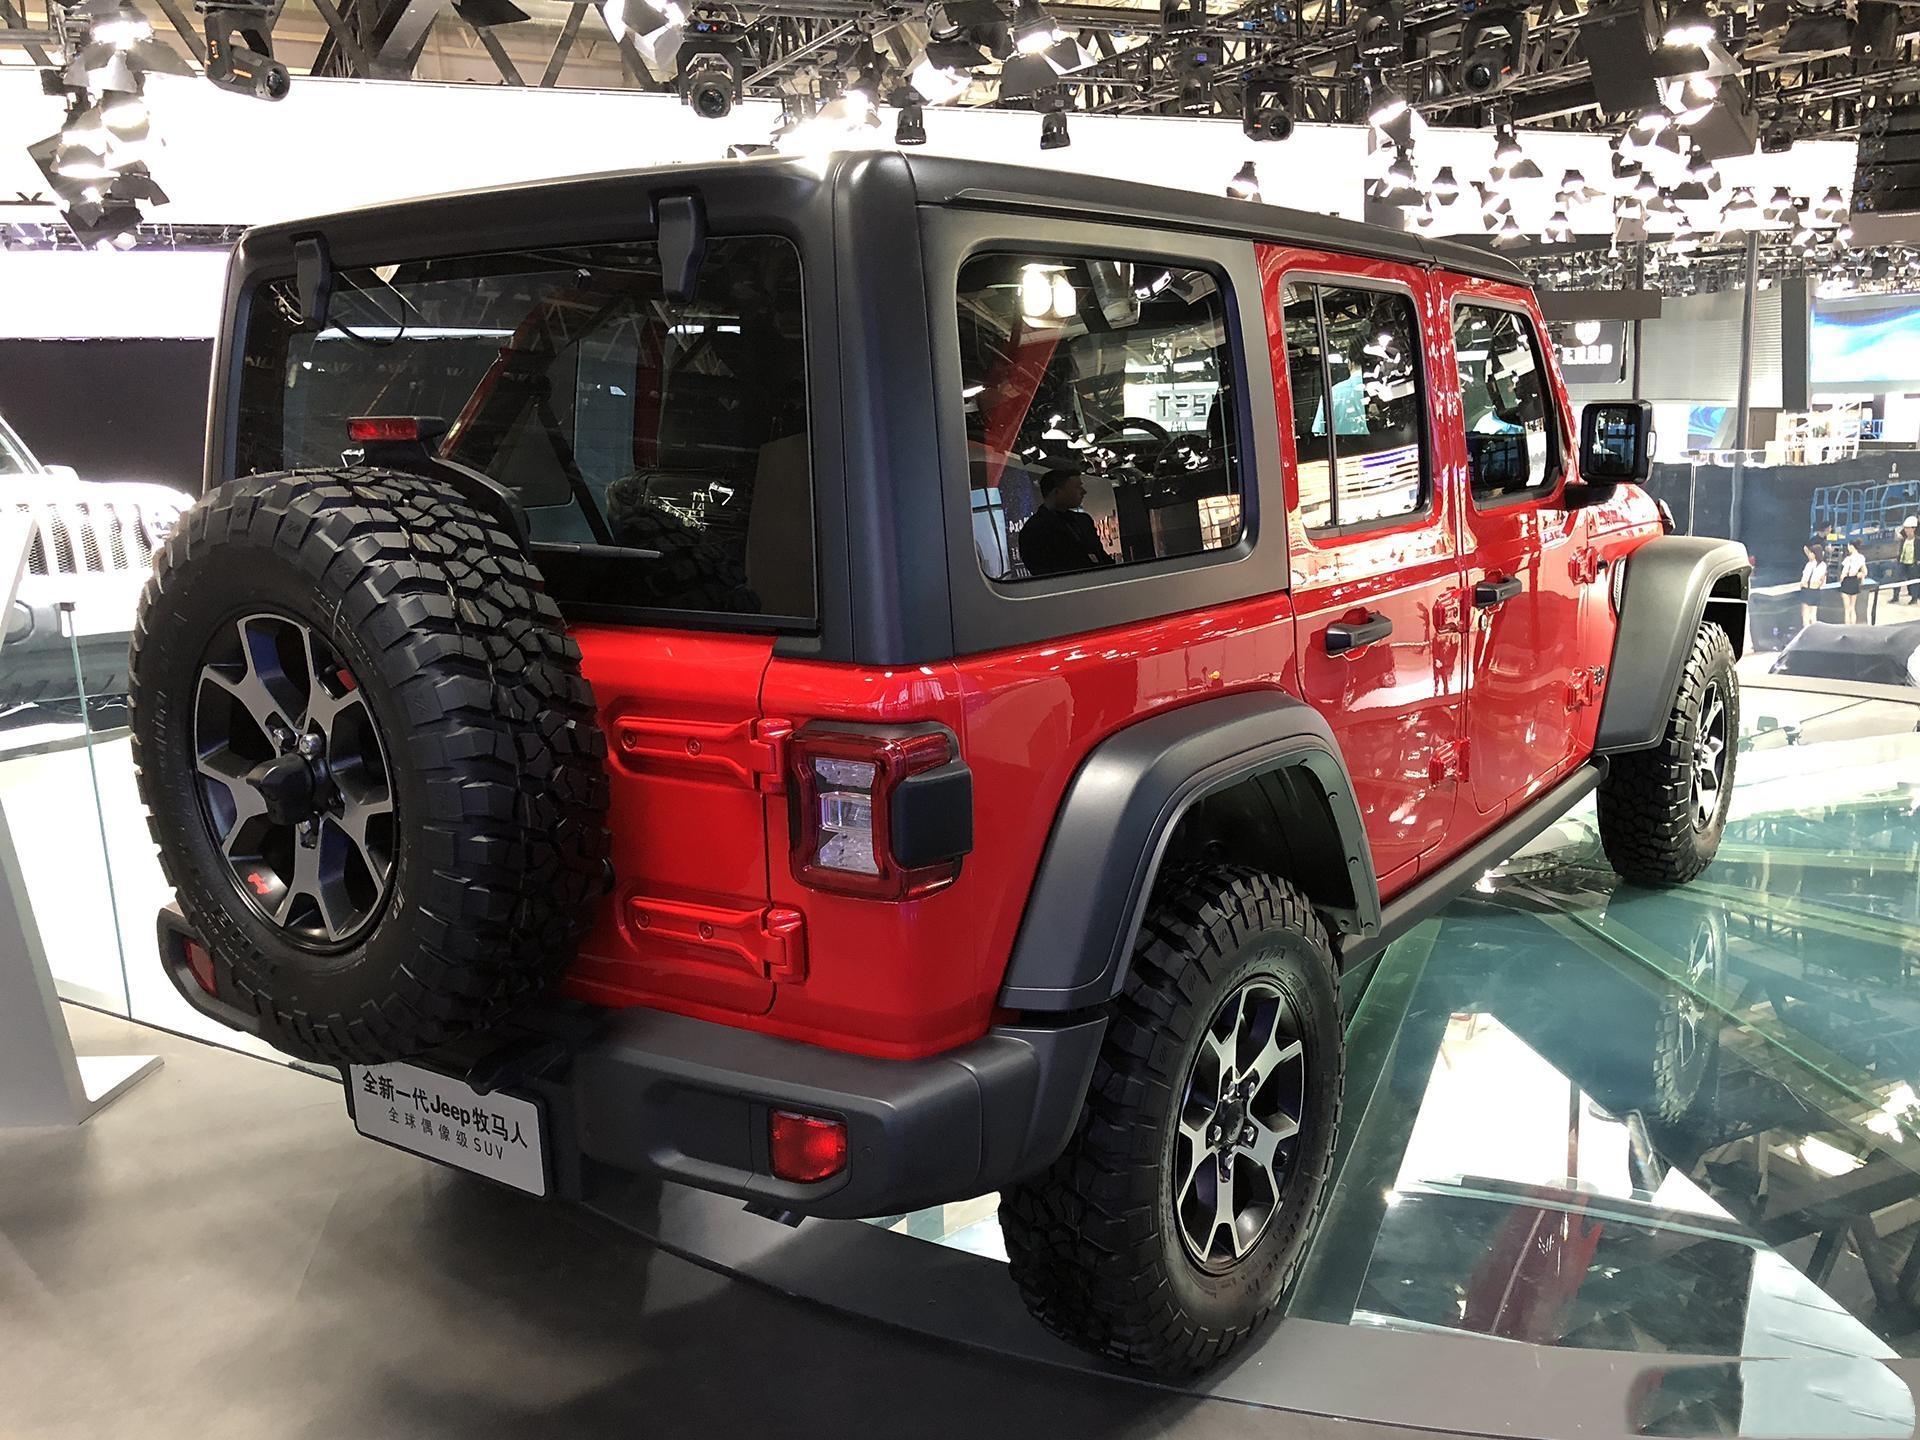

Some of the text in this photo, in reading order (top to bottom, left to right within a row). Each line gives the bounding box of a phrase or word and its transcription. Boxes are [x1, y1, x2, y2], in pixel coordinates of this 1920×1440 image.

[1157, 392, 1216, 418] TES
[362, 1070, 528, 1149] 全新一代Jeep牧马人
